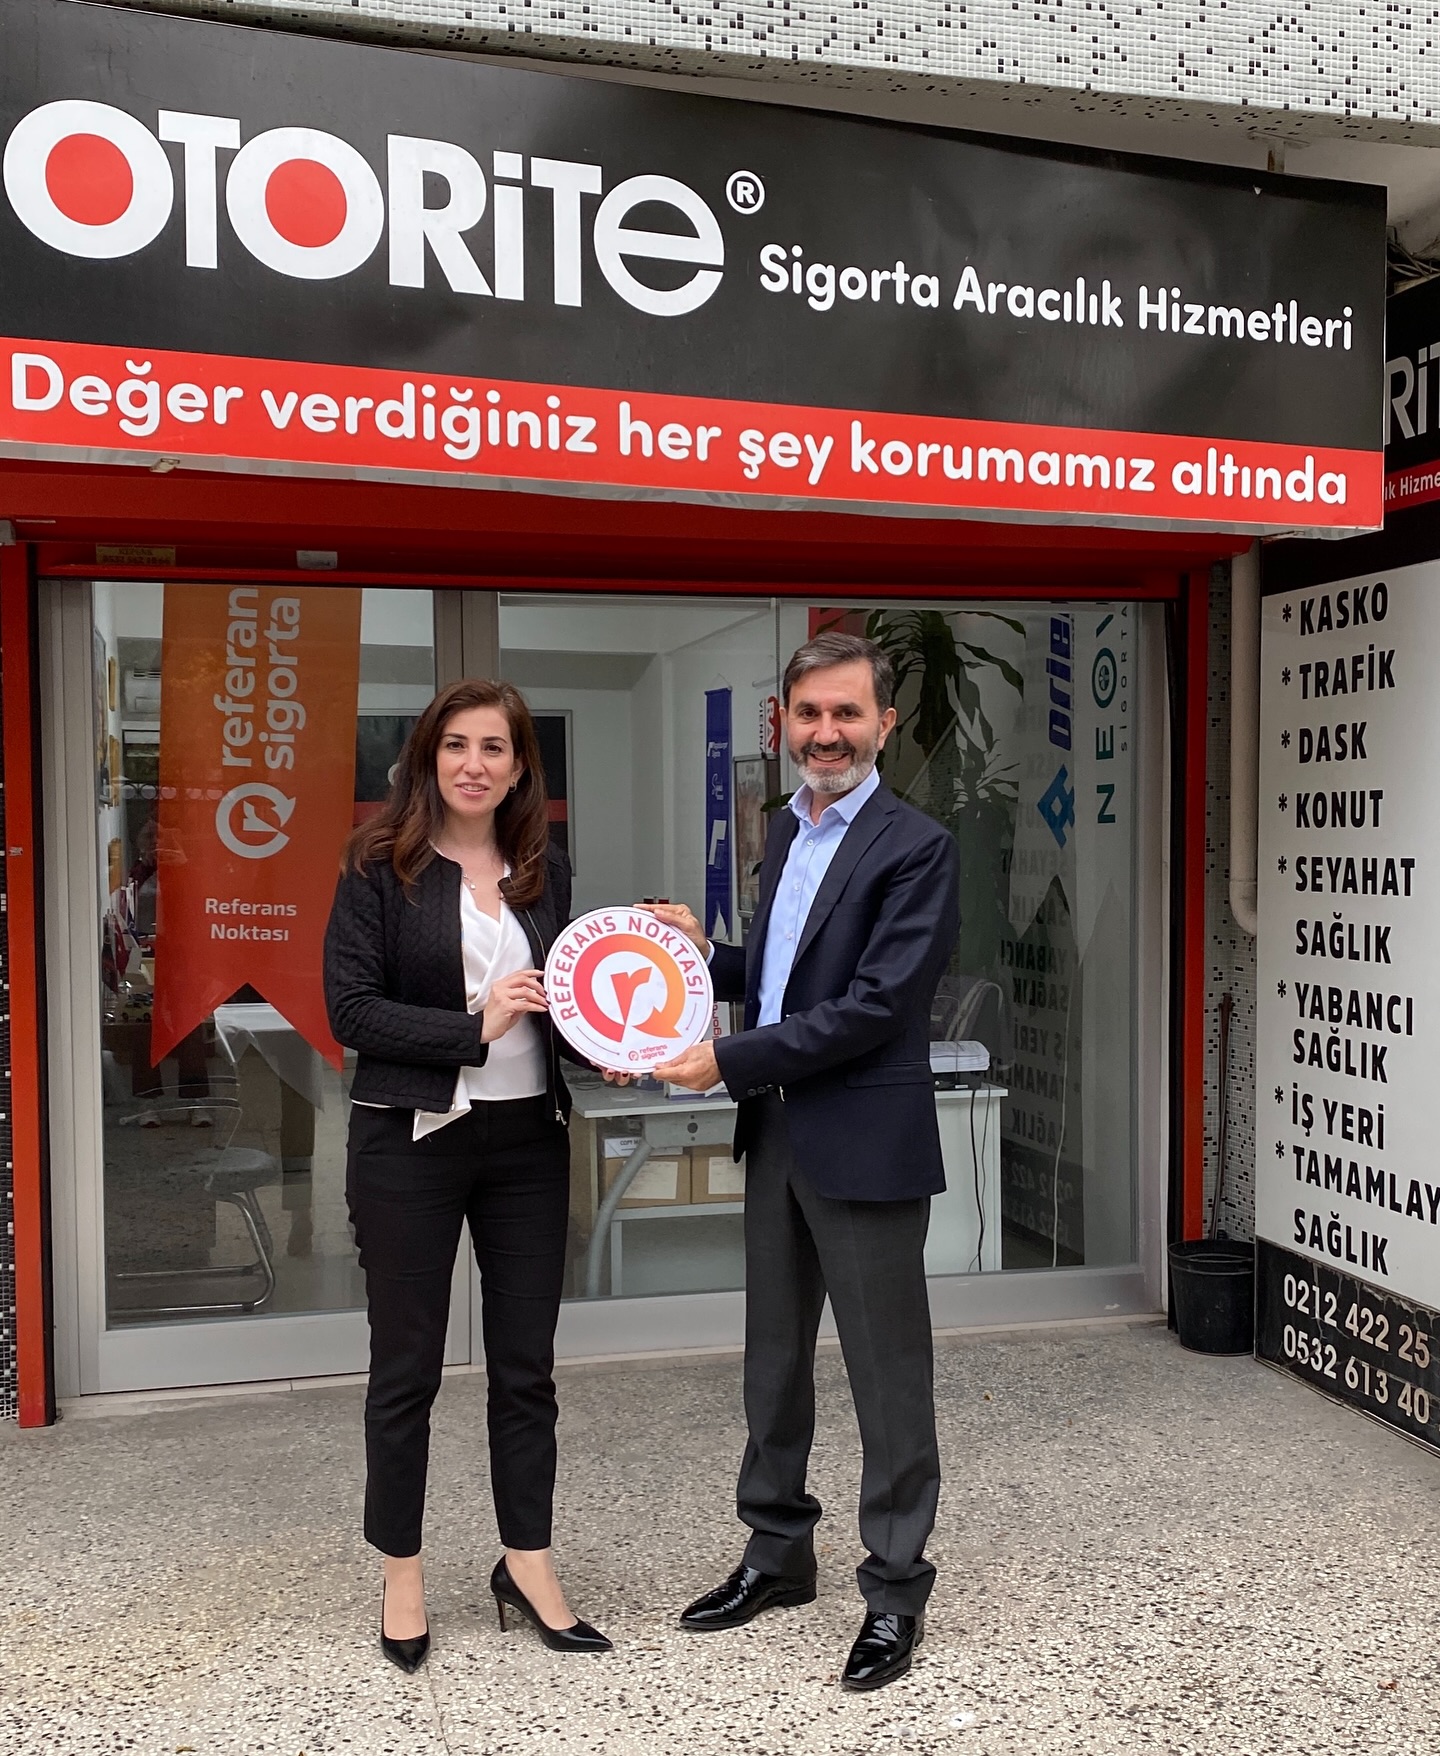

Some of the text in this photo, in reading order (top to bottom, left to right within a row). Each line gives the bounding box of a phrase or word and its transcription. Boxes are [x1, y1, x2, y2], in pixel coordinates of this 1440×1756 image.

[759, 244, 1354, 350] Sigorta Aracılık Hizmetleri
[10, 351, 1347, 505] Değer verdiğiniz her şey korumamız altında
[1299, 582, 1389, 636] KASKO
[258, 597, 307, 771] sigorta
[1298, 643, 1396, 701] TRAFİK
[1298, 721, 1368, 764] DASK
[1295, 788, 1384, 829] KONUT
[1294, 855, 1416, 898] SEYAHAT
[204, 897, 298, 918] Referans
[209, 923, 290, 942] Noktası
[1294, 911, 1393, 965] SAĞLIK
[553, 915, 705, 1021] REFERANS NOKTASI
[1294, 981, 1415, 1036] YABANCI
[639, 1044, 669, 1054] referans
[641, 1051, 666, 1060] sigorta
[1292, 1026, 1388, 1084] SAĞLIK
[1291, 1082, 1386, 1151] İŞ YERİ
[1293, 1208, 1389, 1276] SAĞLIK
[1283, 1273, 1430, 1369] 0212 422 25
[1283, 1324, 1430, 1424] 0532 613 40
